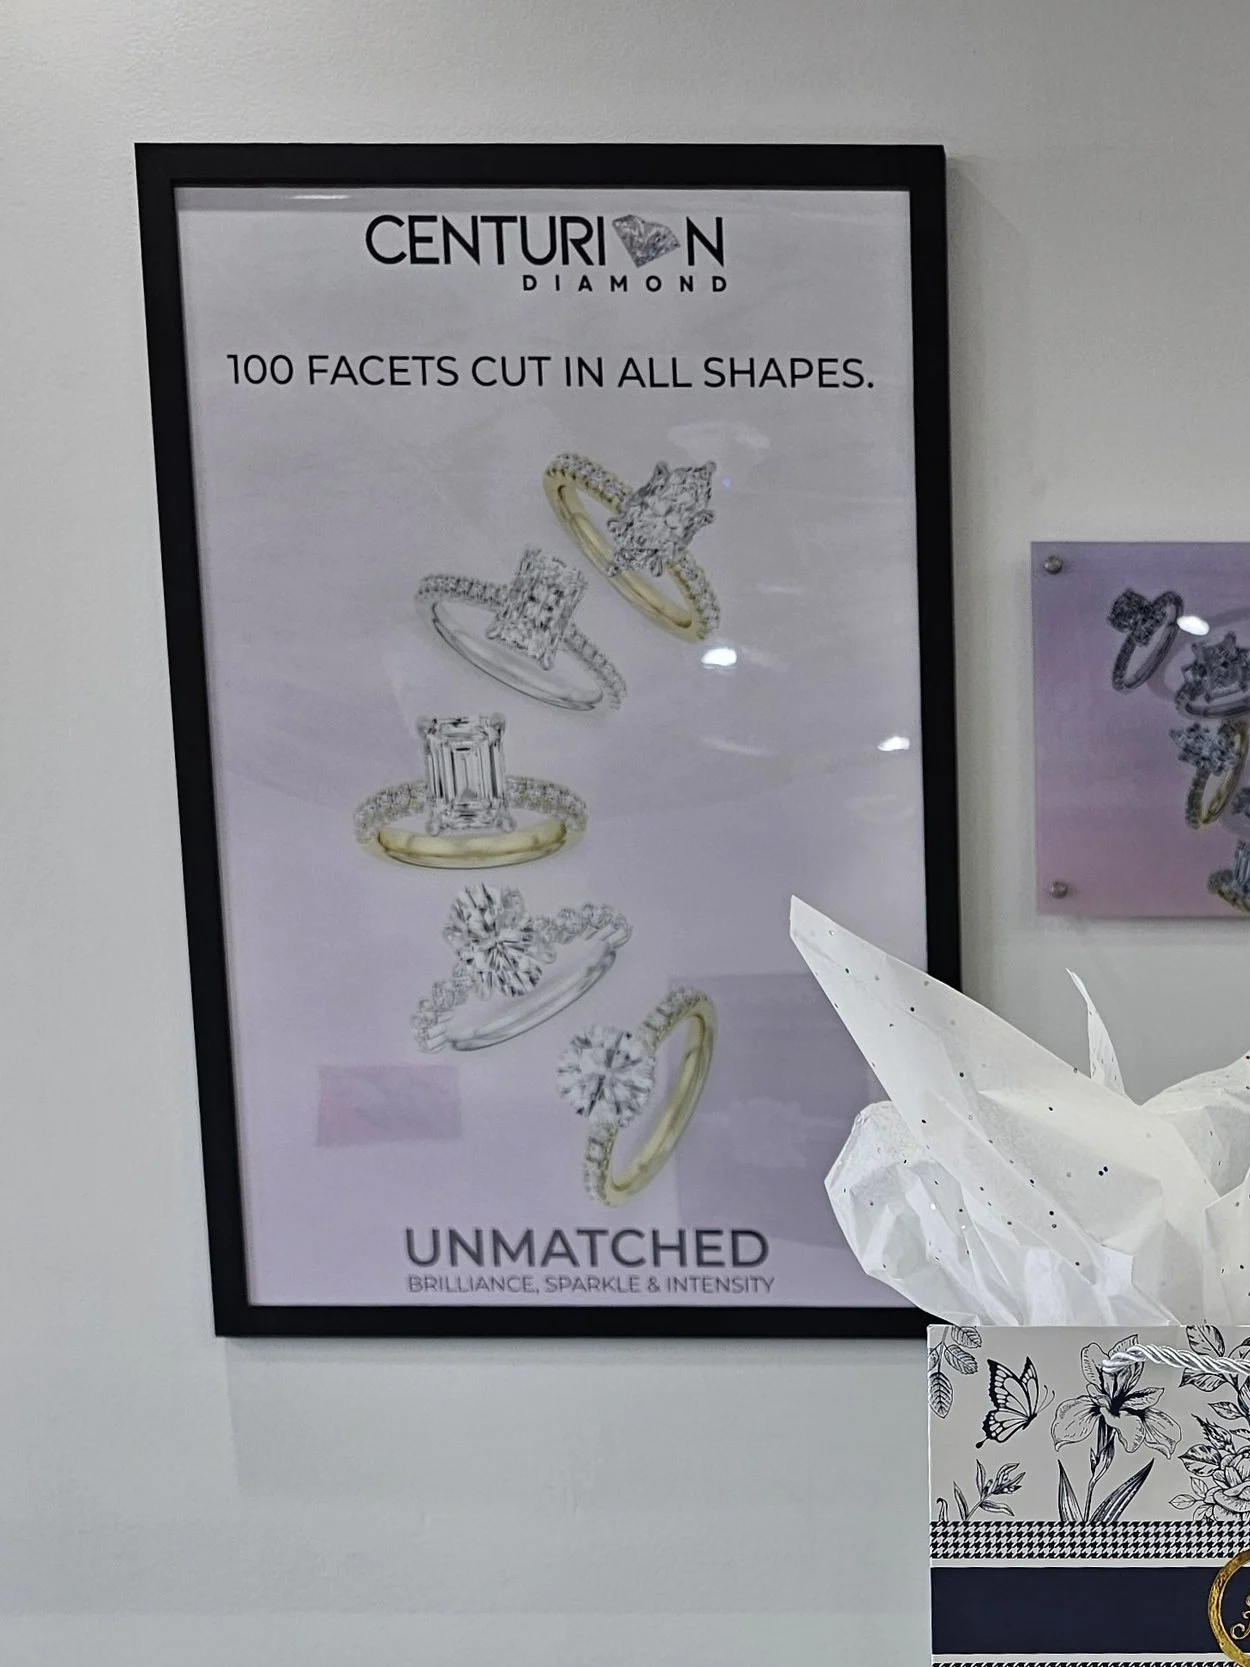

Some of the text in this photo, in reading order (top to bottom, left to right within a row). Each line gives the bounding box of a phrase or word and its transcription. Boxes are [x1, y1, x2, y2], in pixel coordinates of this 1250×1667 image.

[522, 274, 728, 293] DIAMOND
[226, 353, 875, 390] 100 FACETS CUT IN ALL SHAPES.
[405, 1227, 770, 1269] UNMATCHED
[407, 1274, 776, 1294] BRILLIANCE, SPARKLE & INTENSITY
